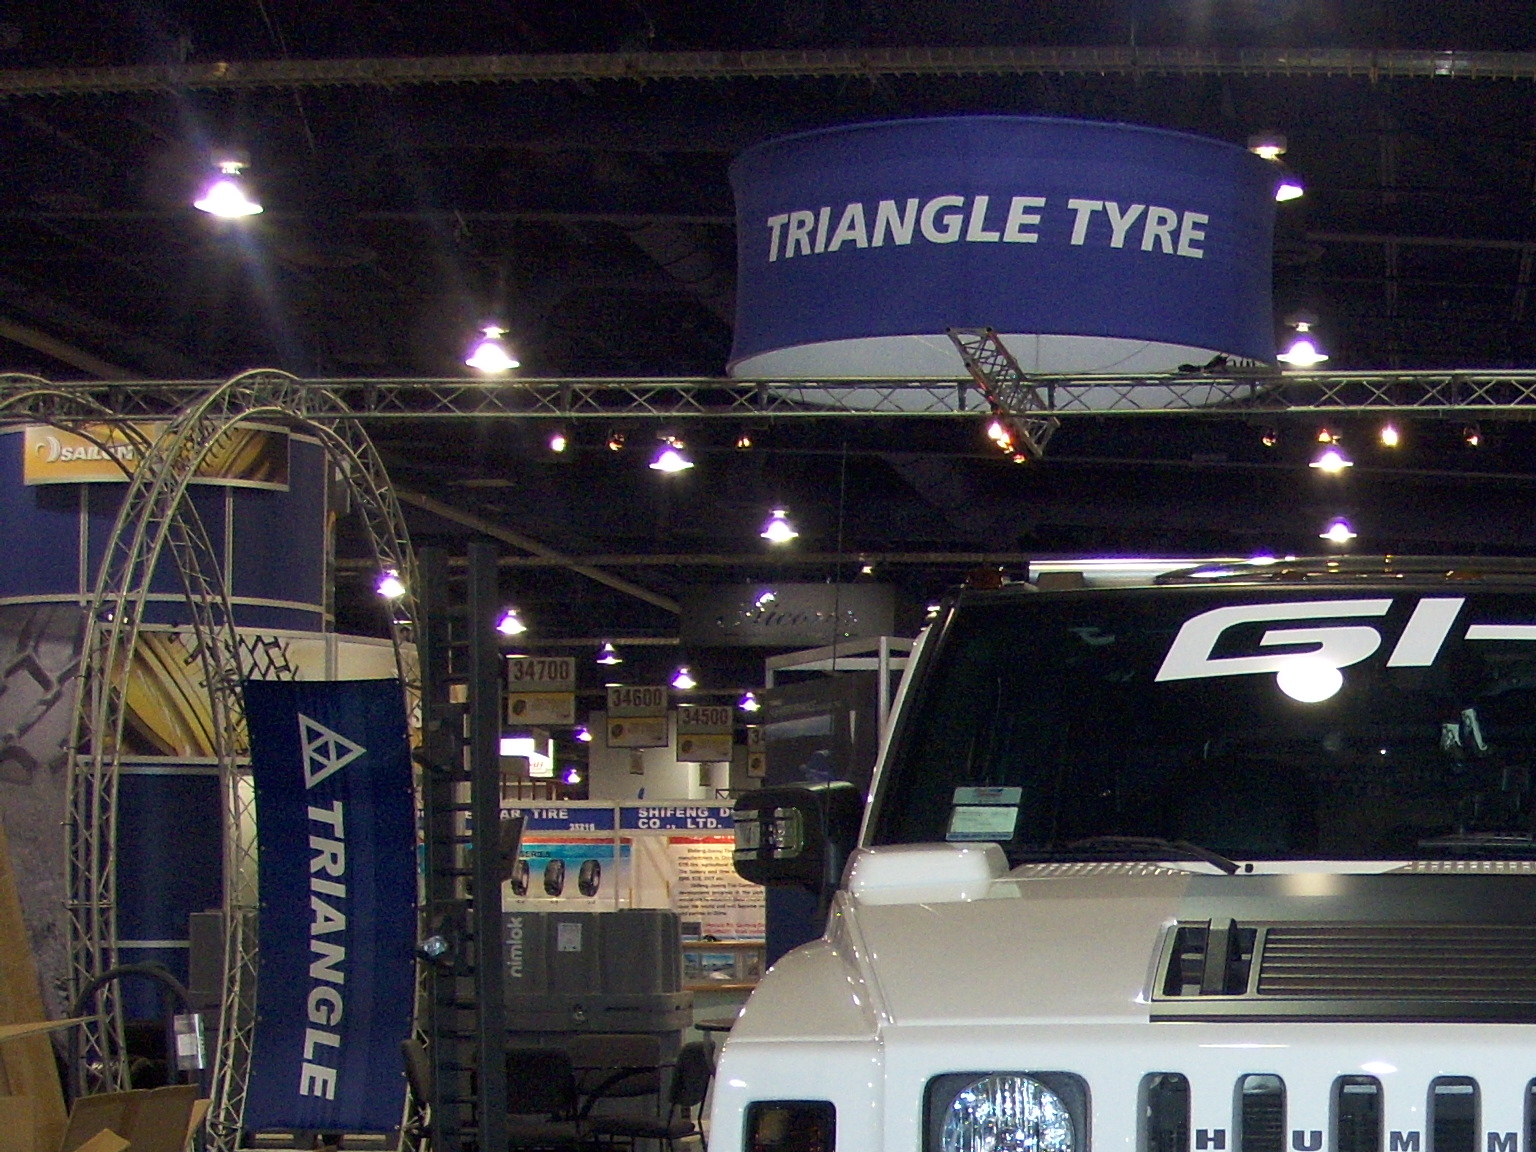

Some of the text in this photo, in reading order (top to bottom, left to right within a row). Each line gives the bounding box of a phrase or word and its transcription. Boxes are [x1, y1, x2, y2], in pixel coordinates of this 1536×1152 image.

[767, 195, 1210, 263] TRIANGLE TYRE
[513, 660, 570, 681] 34700
[612, 689, 661, 707] 34600
[682, 708, 729, 724] 34500
[532, 808, 569, 820] TIRE
[638, 807, 709, 818] SHIFENG
[686, 819, 723, 829] LTD.
[299, 799, 346, 1101] TRIANGLE
[507, 915, 523, 979] nimlok
